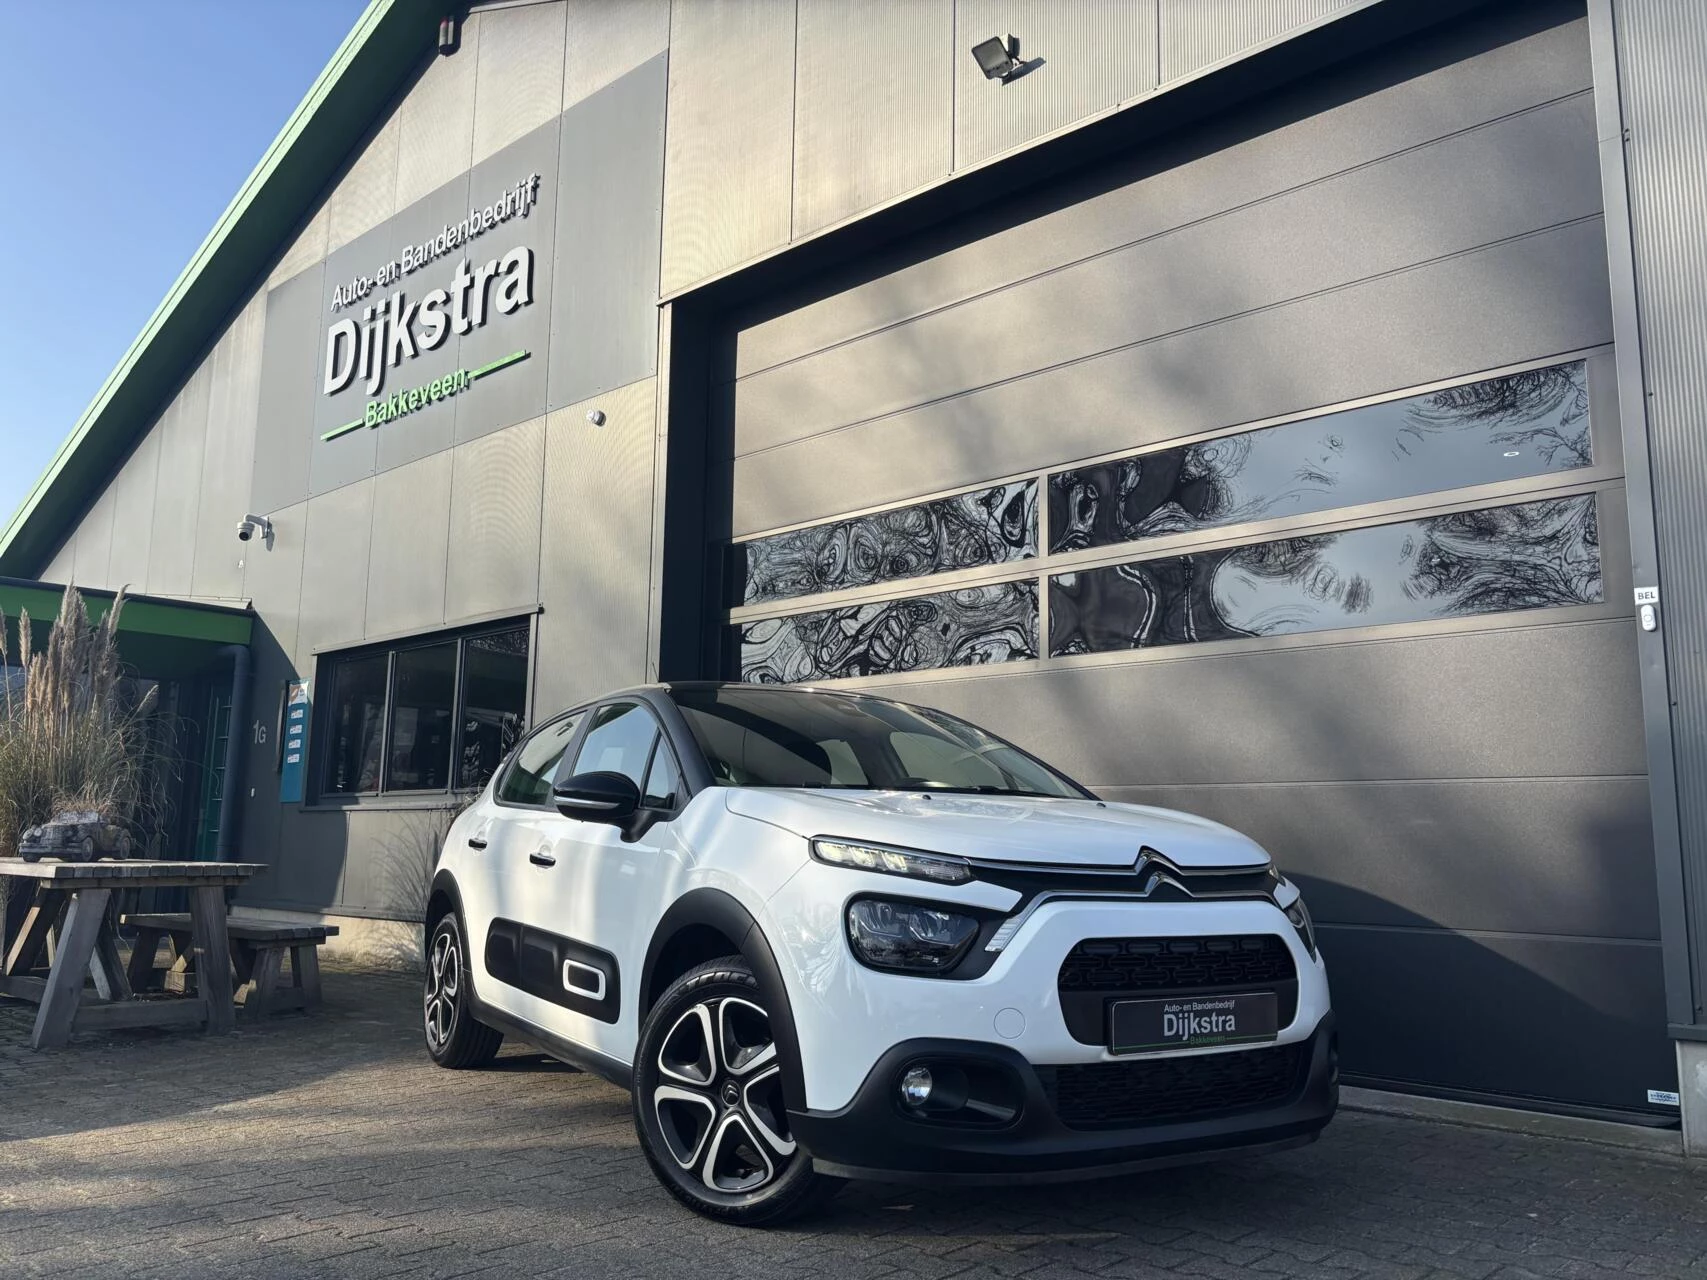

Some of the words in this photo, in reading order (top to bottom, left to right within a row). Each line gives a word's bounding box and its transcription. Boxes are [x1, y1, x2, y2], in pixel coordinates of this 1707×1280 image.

[331, 278, 373, 311] Auto-
[376, 260, 399, 287] en
[400, 172, 541, 274] Bandenbedrijf
[323, 245, 533, 396] Dijkstra
[364, 367, 468, 429] Bakkeveen
[1637, 591, 1656, 600] BEL
[253, 719, 267, 744] 1G
[1164, 1003, 1182, 1012] Auto-
[1192, 1000, 1235, 1011] Bandenbedrijf
[1163, 1011, 1236, 1041] Dijkstra
